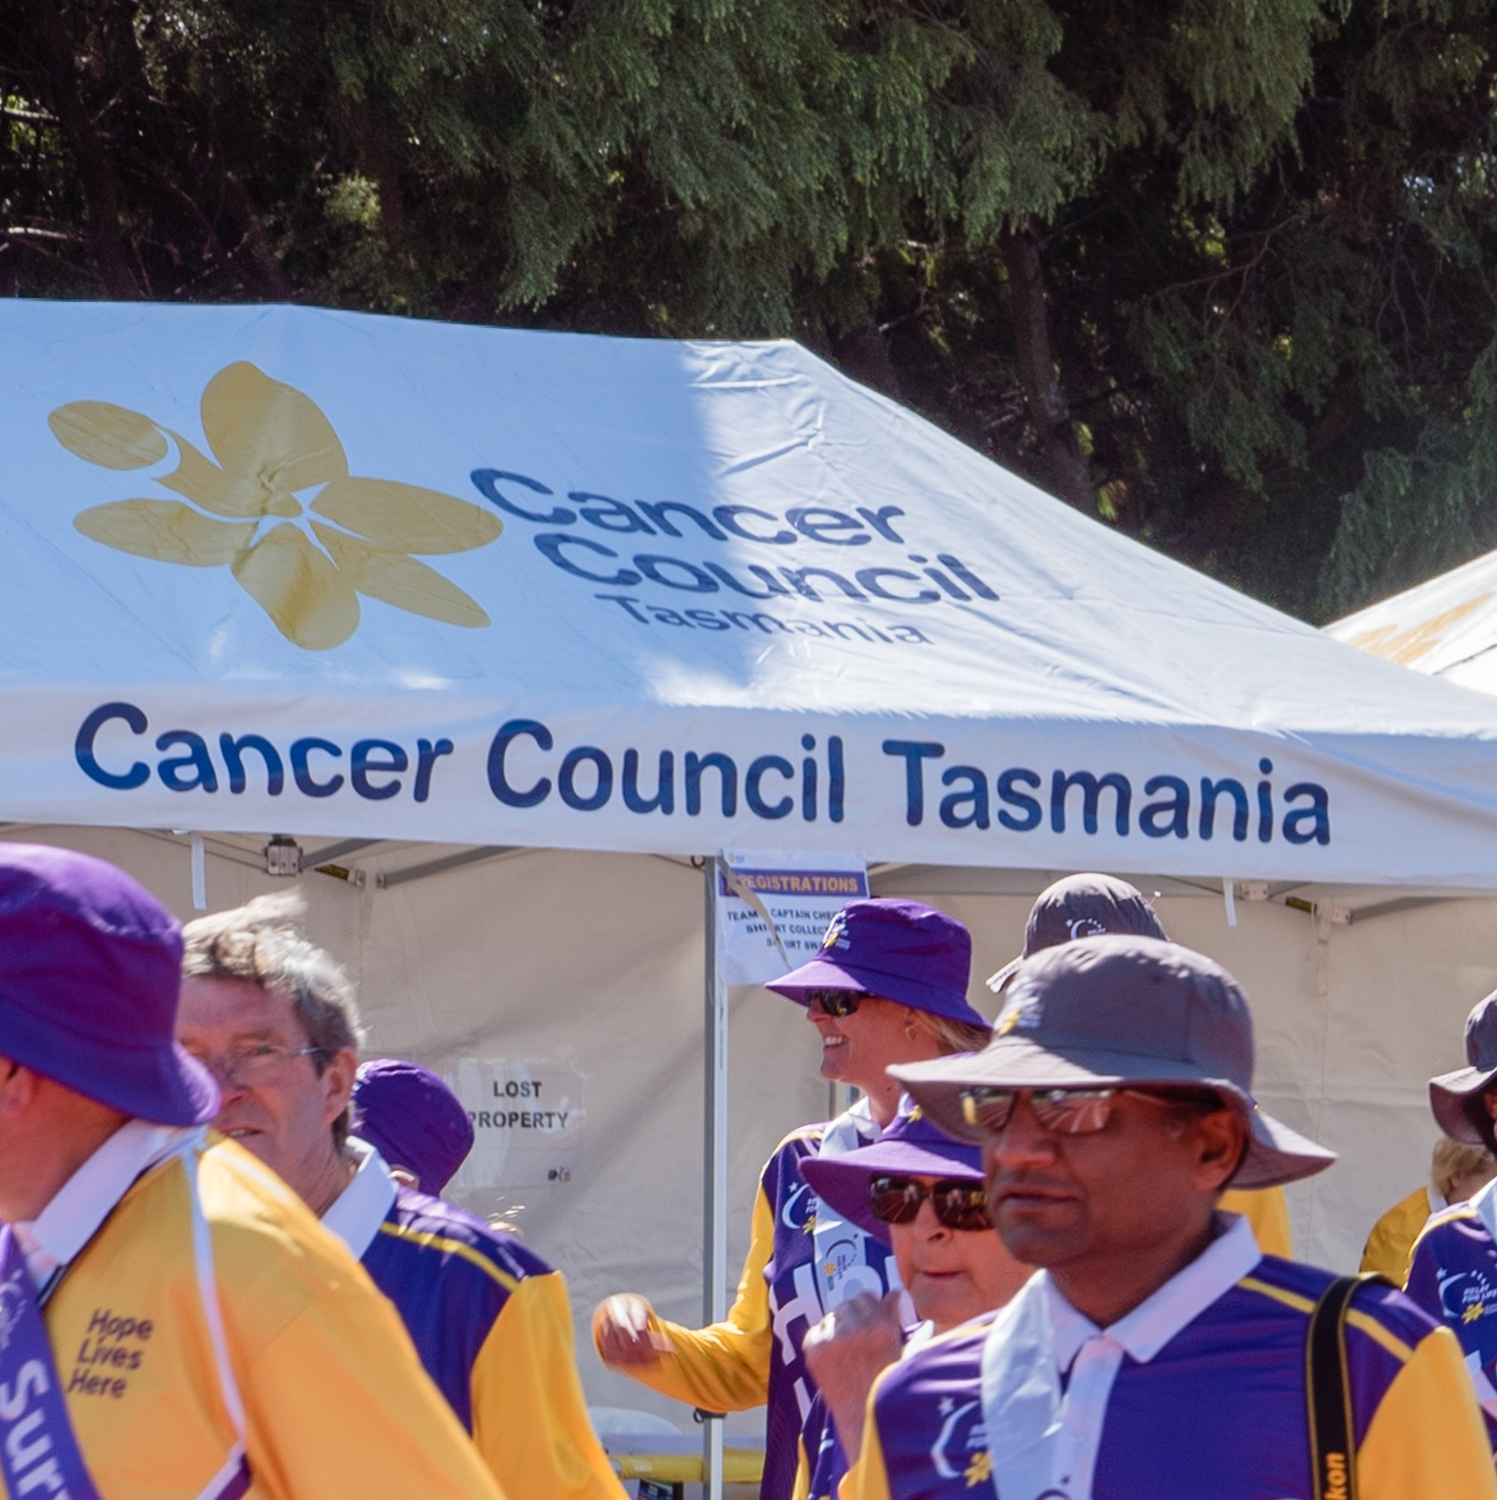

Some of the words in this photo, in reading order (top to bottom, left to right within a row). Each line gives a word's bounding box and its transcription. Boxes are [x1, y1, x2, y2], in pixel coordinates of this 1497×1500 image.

[470, 468, 905, 546] Cancer
[534, 533, 1001, 604] Council
[594, 594, 935, 647] Tasmania
[74, 701, 454, 803] Cancer
[486, 718, 845, 823] Council
[881, 739, 1332, 846] Tasmania
[727, 910, 758, 921] TEAM
[493, 1080, 542, 1098] LOST
[469, 1111, 569, 1130] PROPERTY
[87, 1308, 154, 1342] Hope
[77, 1336, 144, 1370] Lives
[67, 1368, 127, 1399] Here
